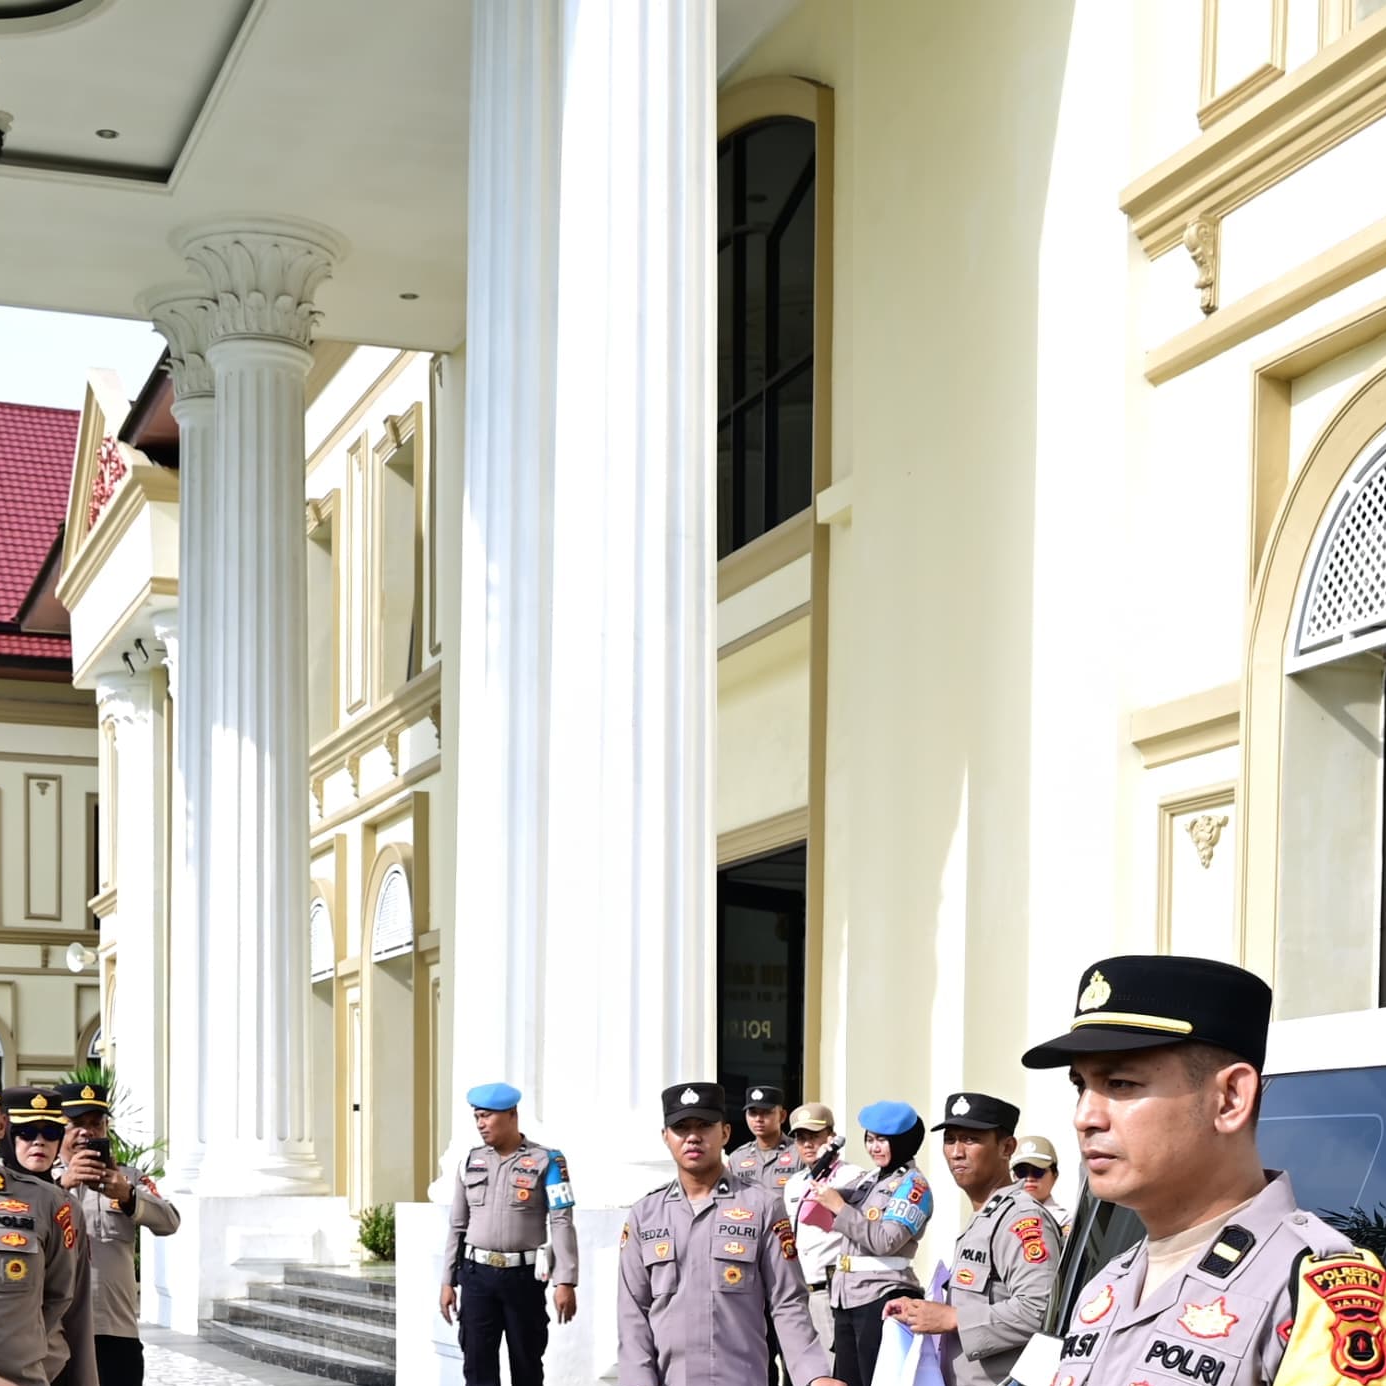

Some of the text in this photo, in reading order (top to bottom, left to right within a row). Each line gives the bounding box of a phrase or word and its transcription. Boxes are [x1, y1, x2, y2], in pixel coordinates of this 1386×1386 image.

[719, 1224, 757, 1240] POLRI
[960, 1248, 987, 1264] POLRI
[1314, 1266, 1381, 1286] POLRESTA
[1327, 1276, 1373, 1289] JAMBI
[1333, 1298, 1377, 1309] JAMBI
[1144, 1340, 1225, 1386] POLRI
